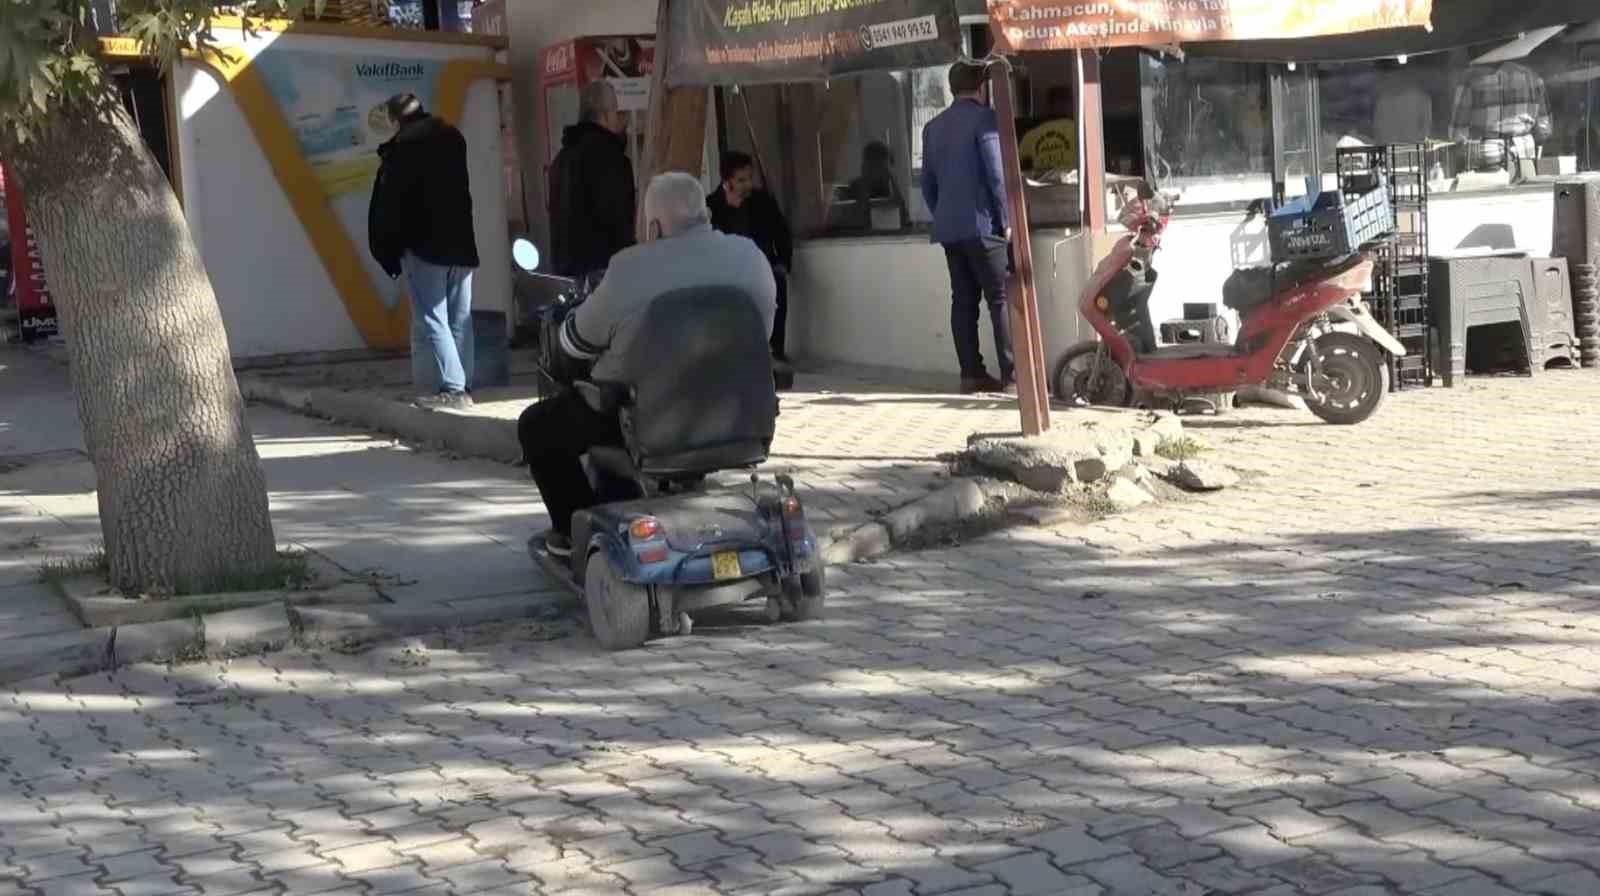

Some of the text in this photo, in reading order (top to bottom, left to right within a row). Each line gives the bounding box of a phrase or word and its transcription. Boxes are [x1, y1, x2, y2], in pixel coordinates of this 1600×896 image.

[1008, 1, 1114, 21] Lahmacun,
[892, 23, 907, 39] 949
[907, 21, 919, 37] 99
[919, 19, 932, 34] 52
[1008, 25, 1061, 40] Odun
[1066, 19, 1150, 38] Ateşinde
[356, 62, 424, 77] VakıfBank
